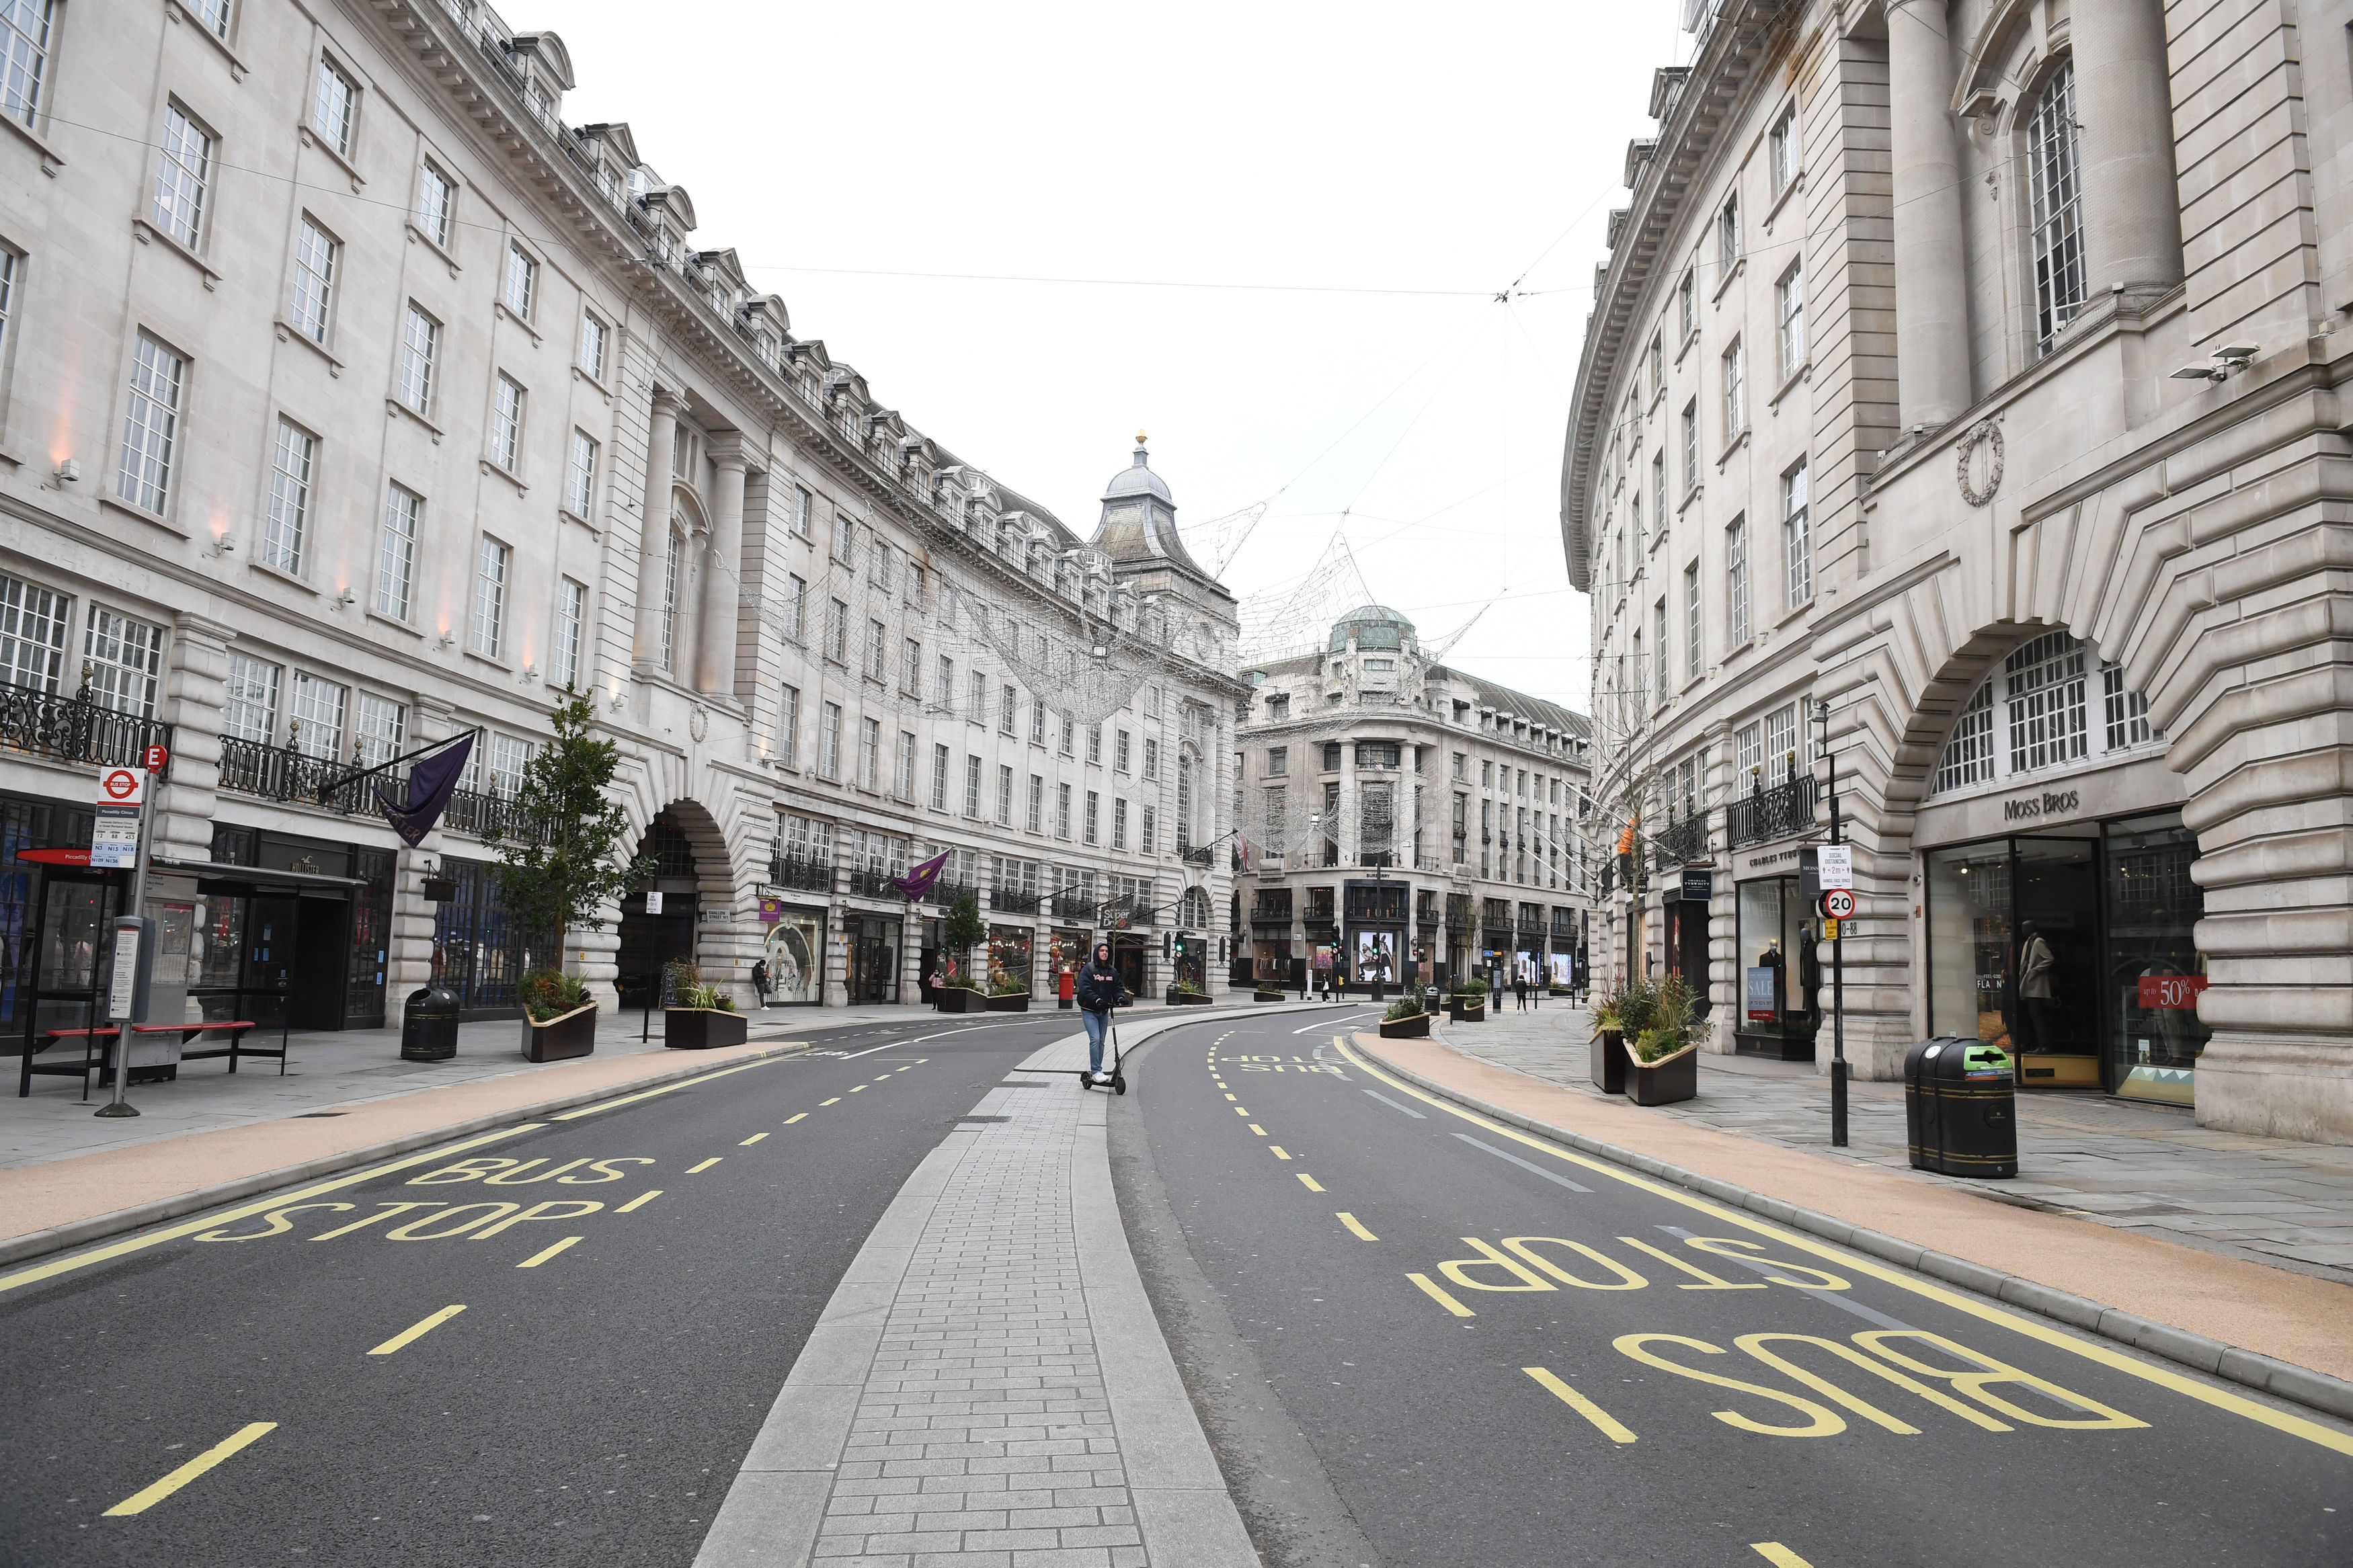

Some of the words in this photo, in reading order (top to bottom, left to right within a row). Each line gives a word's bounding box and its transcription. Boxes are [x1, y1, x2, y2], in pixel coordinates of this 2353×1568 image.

[148, 748, 160, 766] E
[1749, 854, 1778, 866] CHARLES
[292, 862, 319, 874] HOLLISTER
[1831, 897, 1851, 910] 20
[1104, 909, 1129, 920] Super
[1841, 921, 1858, 935] 0-88
[1749, 981, 1773, 995] SALE
[2160, 979, 2190, 1005] 50%
[1220, 1055, 1346, 1064] STOP
[1240, 1064, 1344, 1074] BUS
[405, 1157, 656, 1185] BUS
[193, 1200, 604, 1242] STOP
[1437, 1236, 1853, 1292] STOP
[1612, 1330, 2153, 1438] BUS
